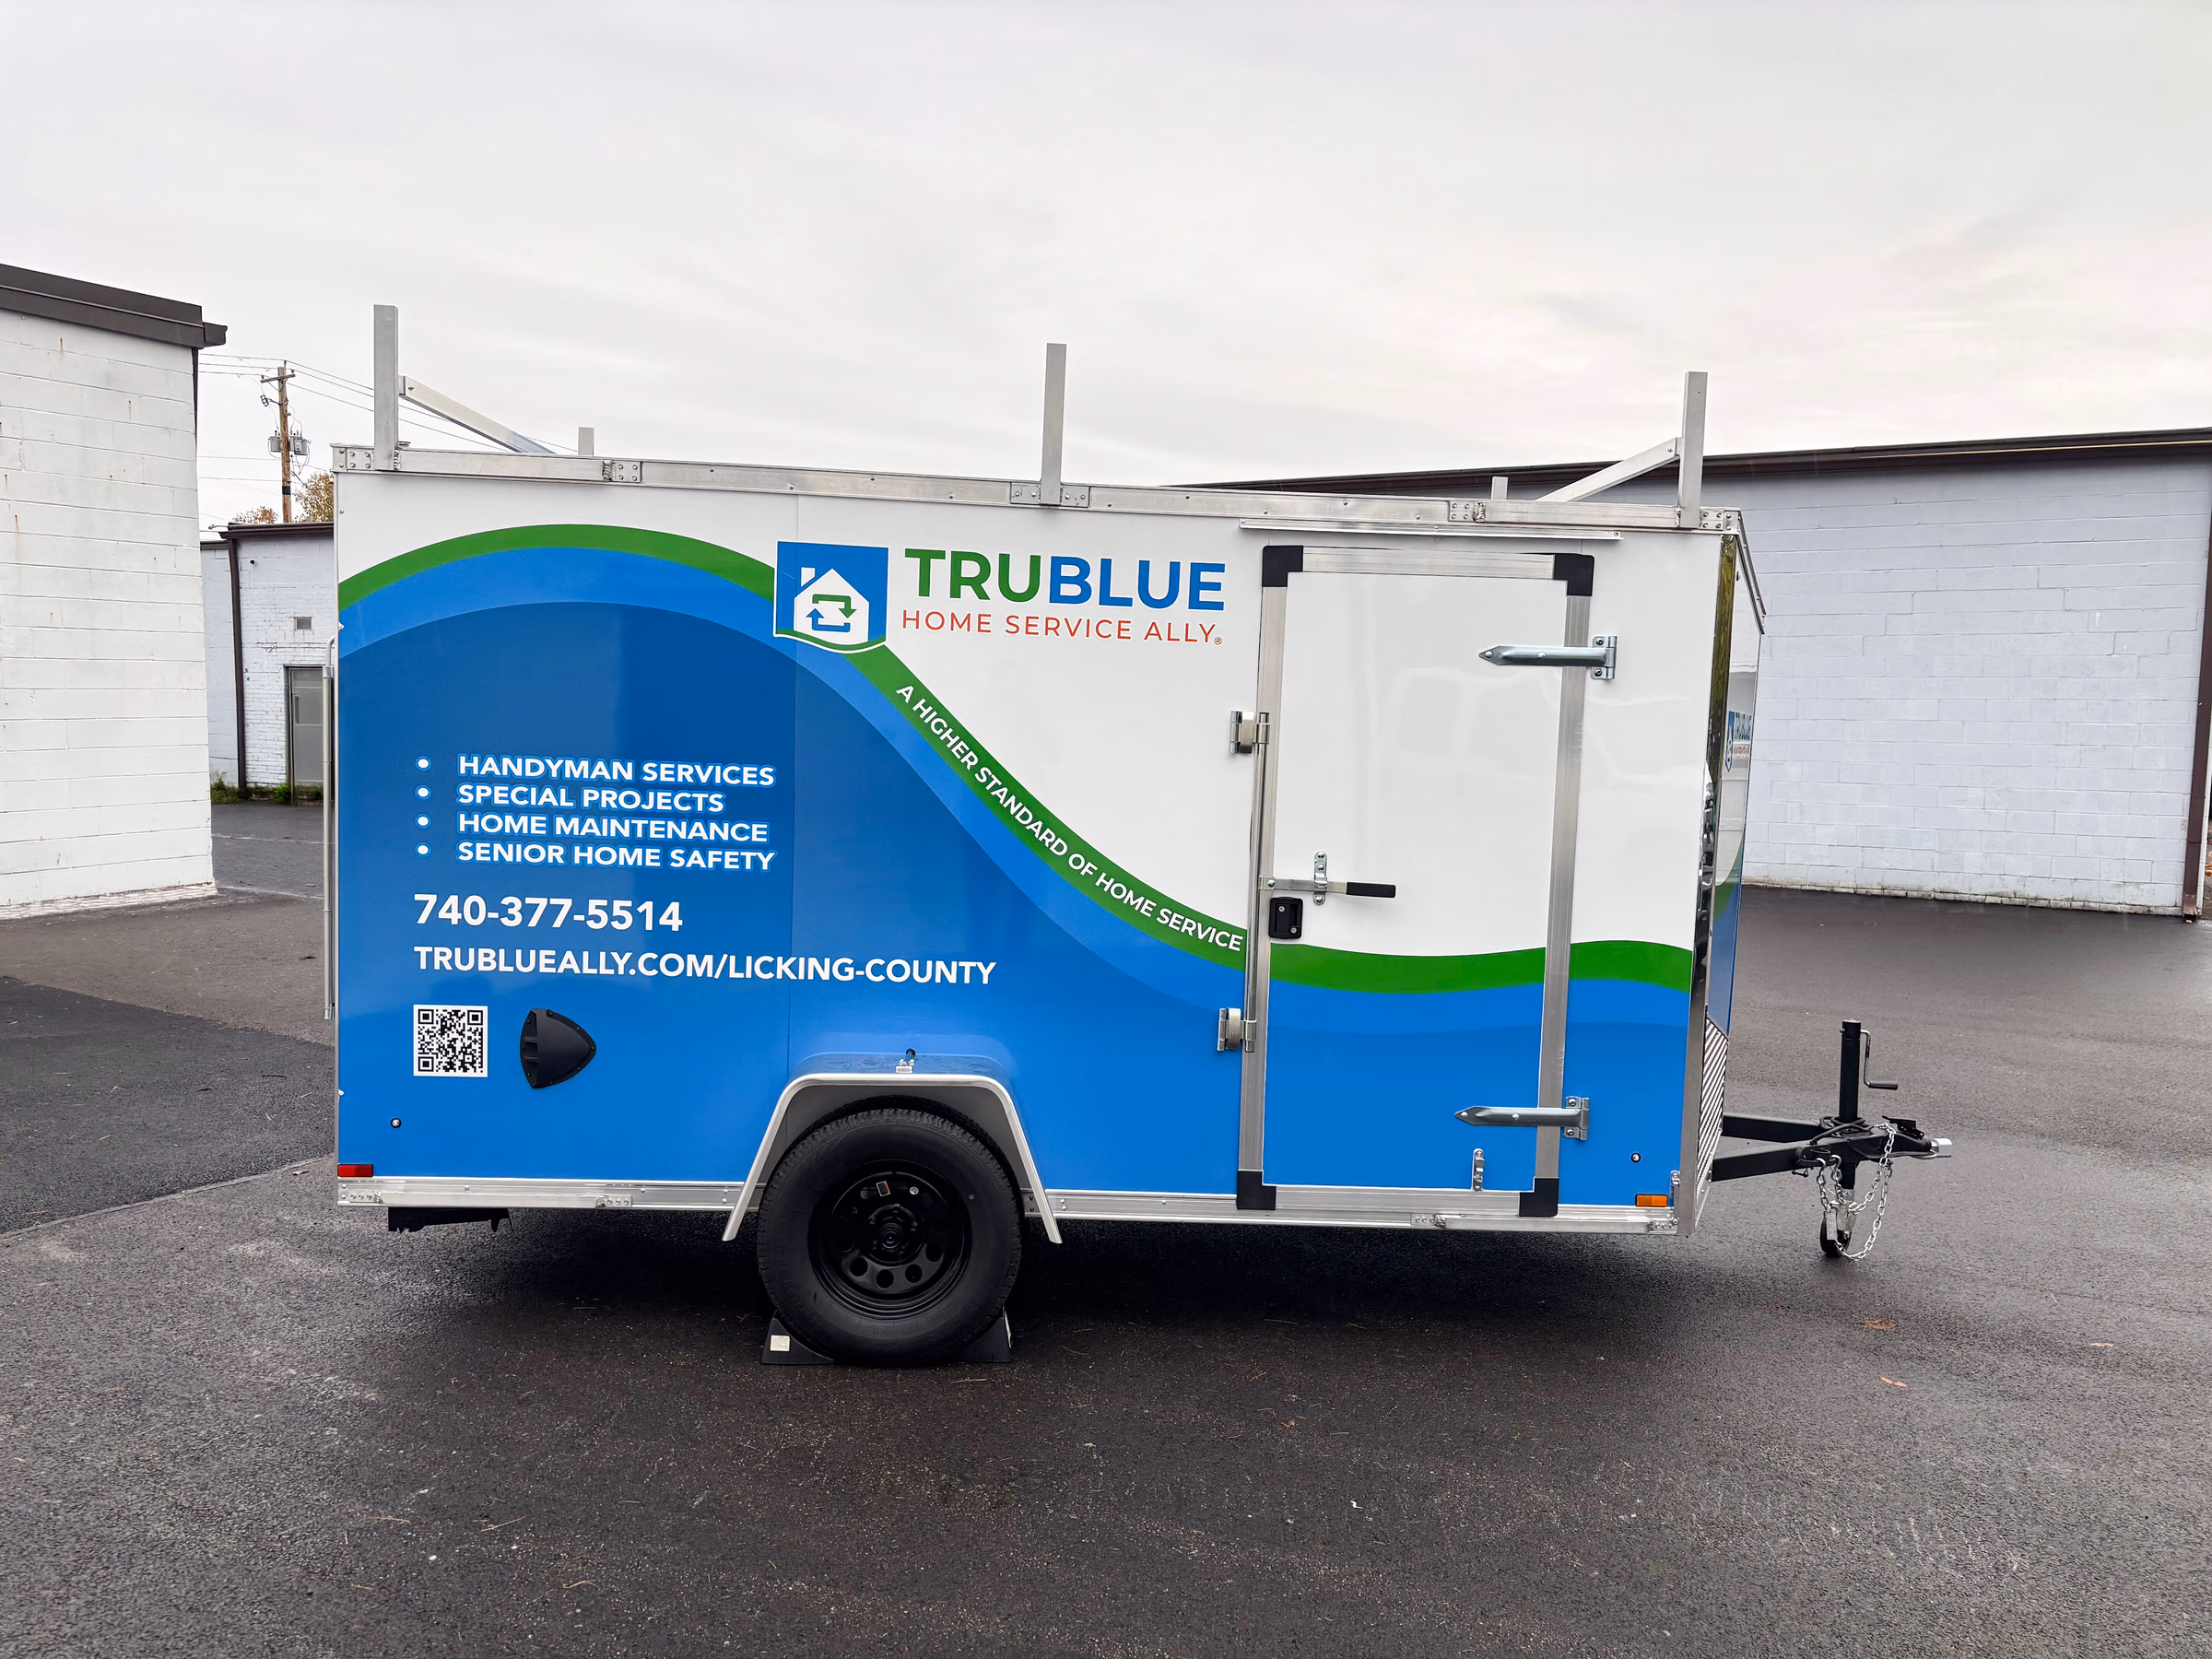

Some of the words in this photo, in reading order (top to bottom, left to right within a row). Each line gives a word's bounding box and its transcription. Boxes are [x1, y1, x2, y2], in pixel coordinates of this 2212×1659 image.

[904, 547, 1226, 611] TRUBLUE
[902, 609, 993, 634] HOME
[1005, 615, 1133, 641] SERVICE
[459, 756, 633, 781] HANDYMAN
[641, 762, 774, 786] SERVICES
[458, 784, 574, 807] SPECIAL
[582, 789, 724, 813] PROJECTS
[459, 813, 547, 835] HOME
[555, 817, 769, 842] MAINTENANCE
[896, 685, 914, 703] A
[912, 698, 979, 771] HIGHER
[974, 767, 1067, 856] STANDARD
[1068, 853, 1098, 877] OF
[1095, 872, 1157, 917] HOME
[1156, 908, 1244, 951] SERVICE
[458, 841, 565, 865] SENIOR
[573, 845, 662, 866] HOME
[669, 849, 776, 871] SAFETY
[414, 893, 684, 932] 740-377-5514
[414, 946, 997, 984] TRUBLUEALLY.COM/LICKING-COUNTY
